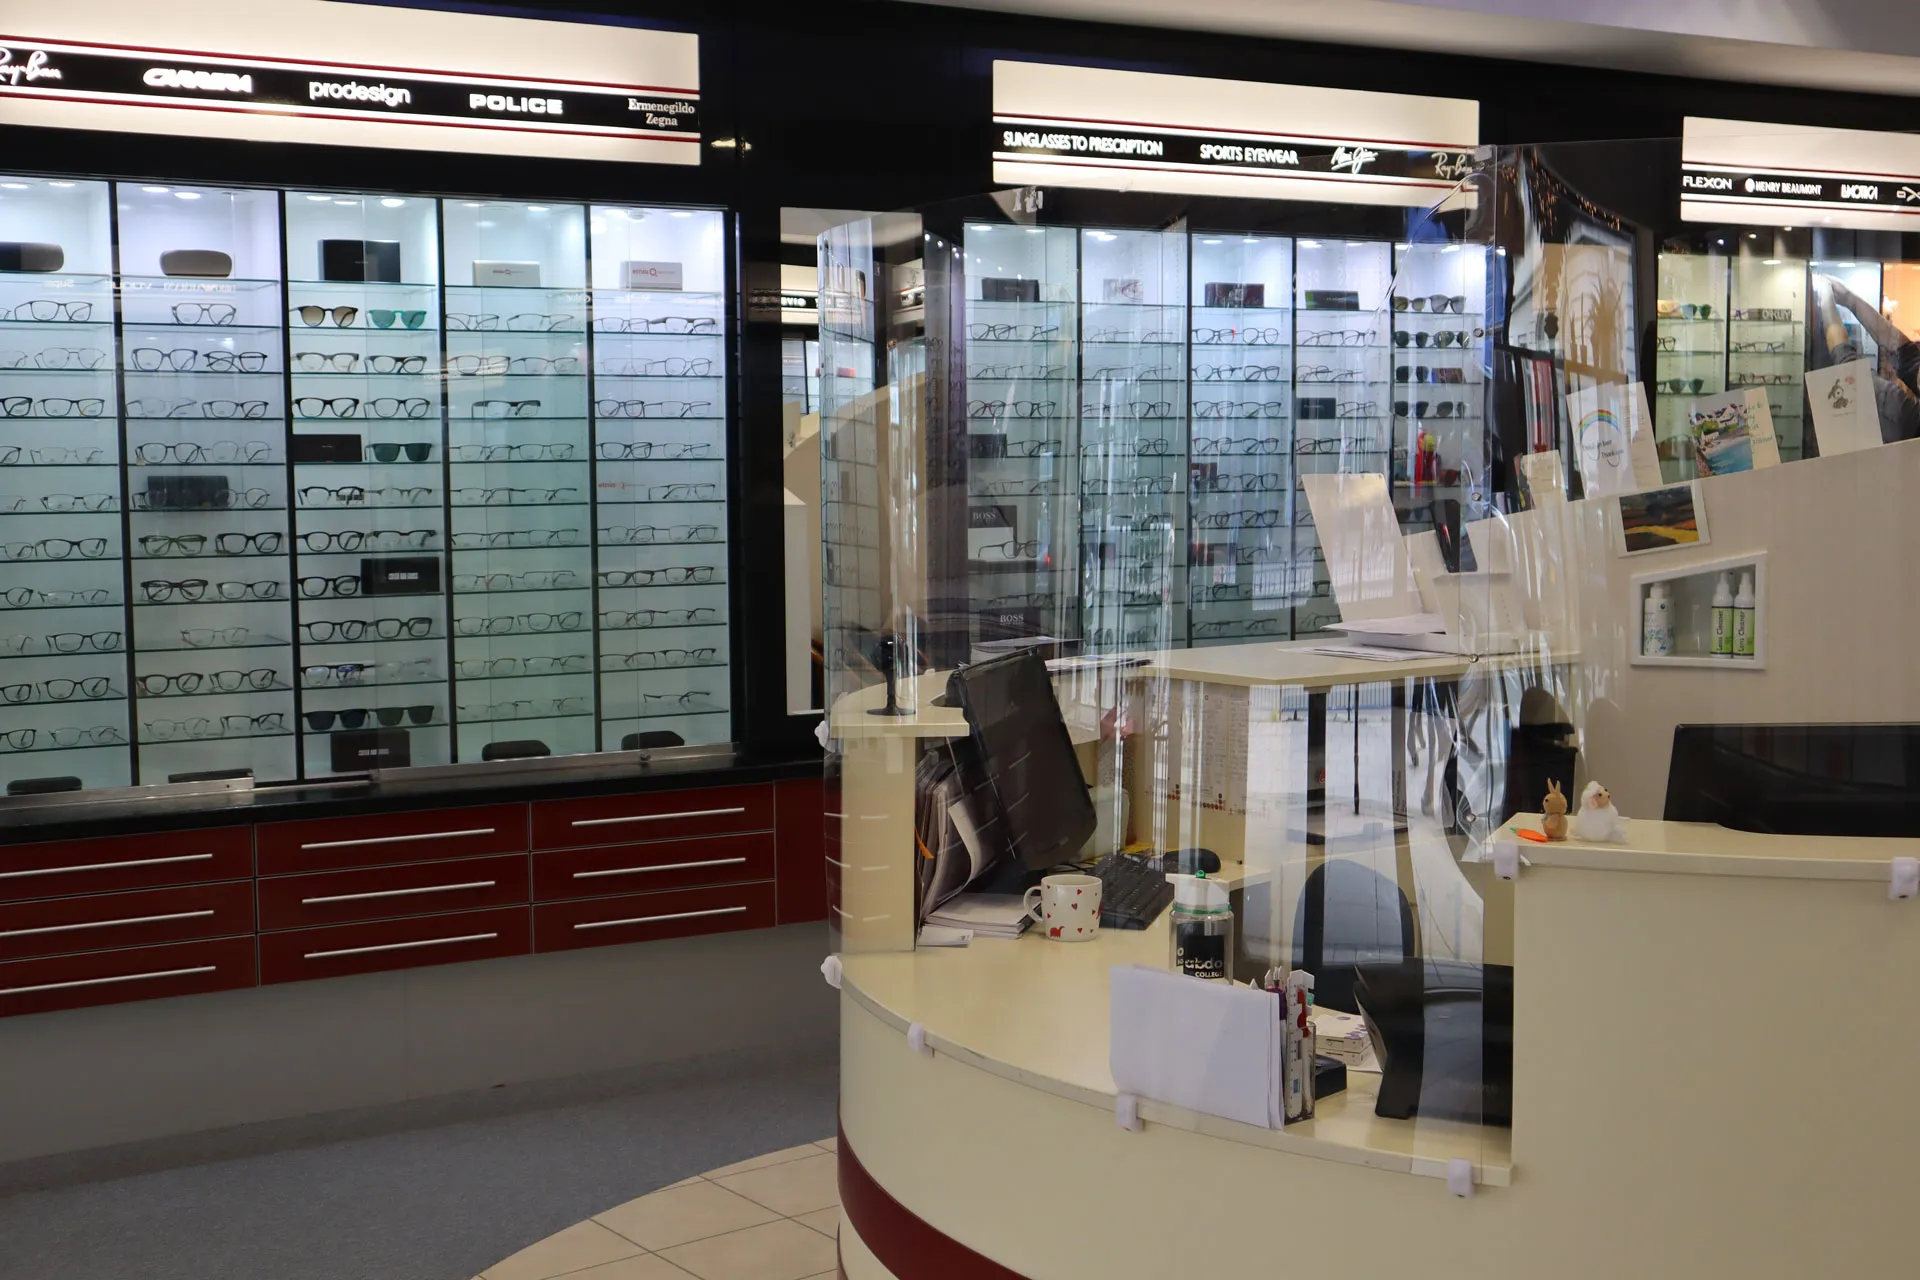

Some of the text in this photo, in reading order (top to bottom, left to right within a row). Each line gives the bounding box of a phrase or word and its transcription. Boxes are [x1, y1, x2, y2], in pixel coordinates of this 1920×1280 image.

[308, 81, 412, 107] prodesign
[468, 93, 564, 115] POLICE
[627, 98, 696, 115] Ermenegildo
[645, 113, 678, 128] Zegna
[1003, 130, 1164, 156] SUNGLASSES TO PRESCRIPTION
[1200, 143, 1300, 165] SPORTS EYEWEAR
[1431, 152, 1473, 179] Ray-Ban
[1682, 175, 1733, 190] FLEXON
[1755, 180, 1823, 196] HENRY BEAUMONT
[972, 511, 996, 520] BOSS
[1000, 614, 1024, 622] BOSS
